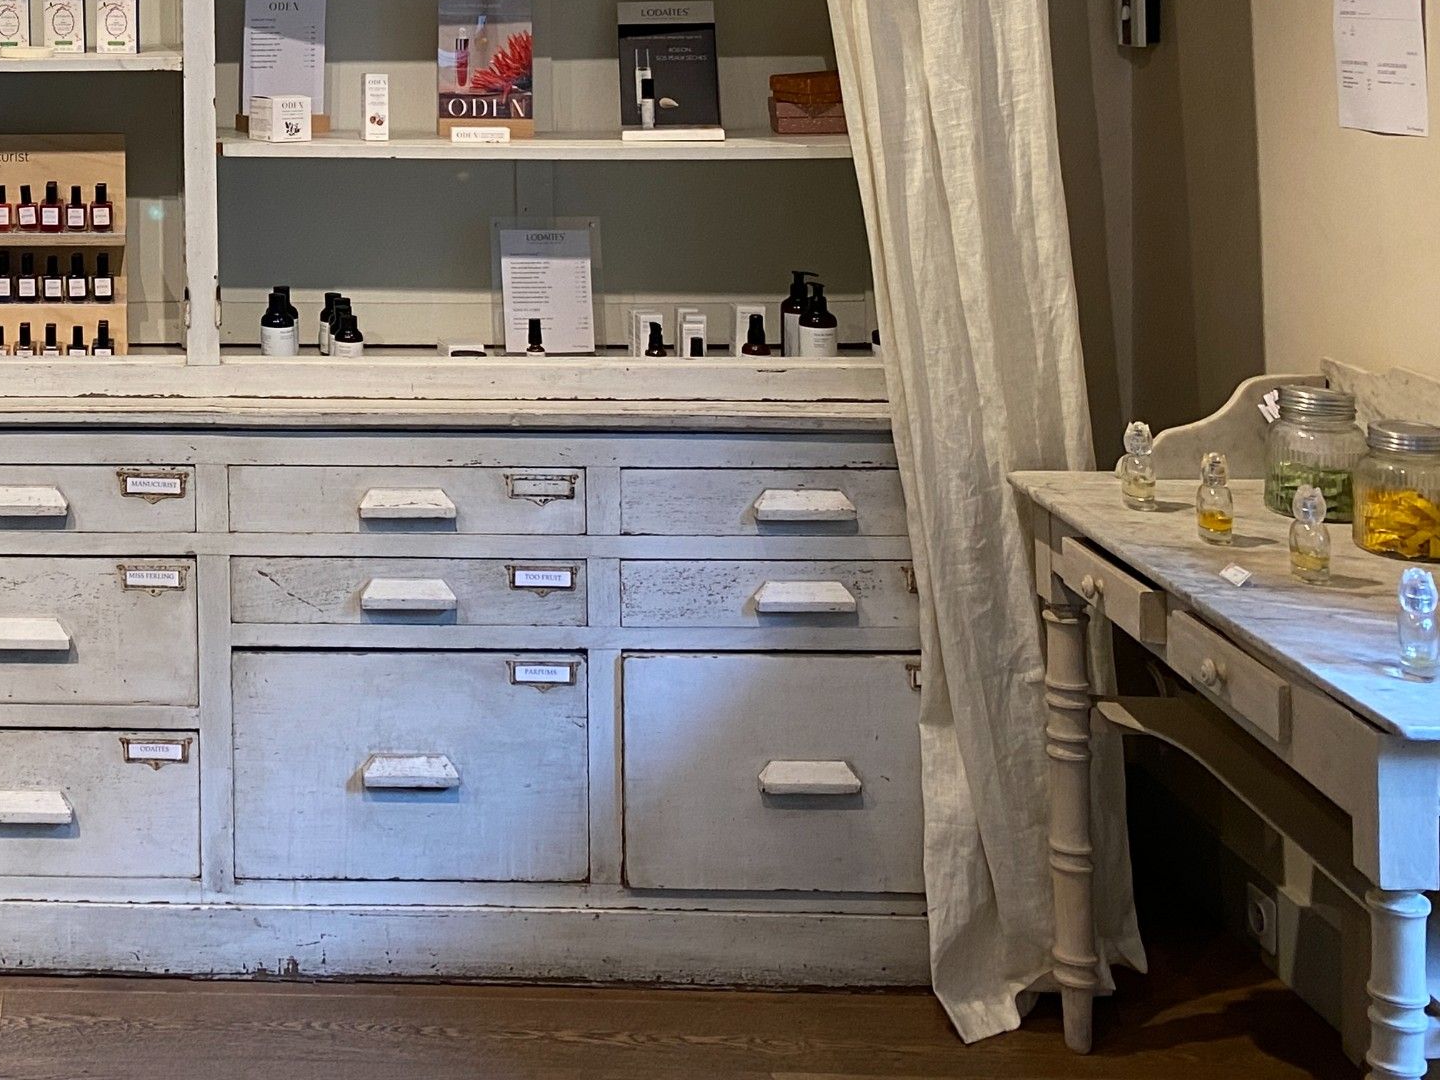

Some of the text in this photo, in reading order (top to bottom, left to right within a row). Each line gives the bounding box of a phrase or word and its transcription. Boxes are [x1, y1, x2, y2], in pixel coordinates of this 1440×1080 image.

[448, 98, 527, 117] ODEN
[131, 480, 177, 489] MANUCURIST
[541, 573, 562, 581] FRUIT
